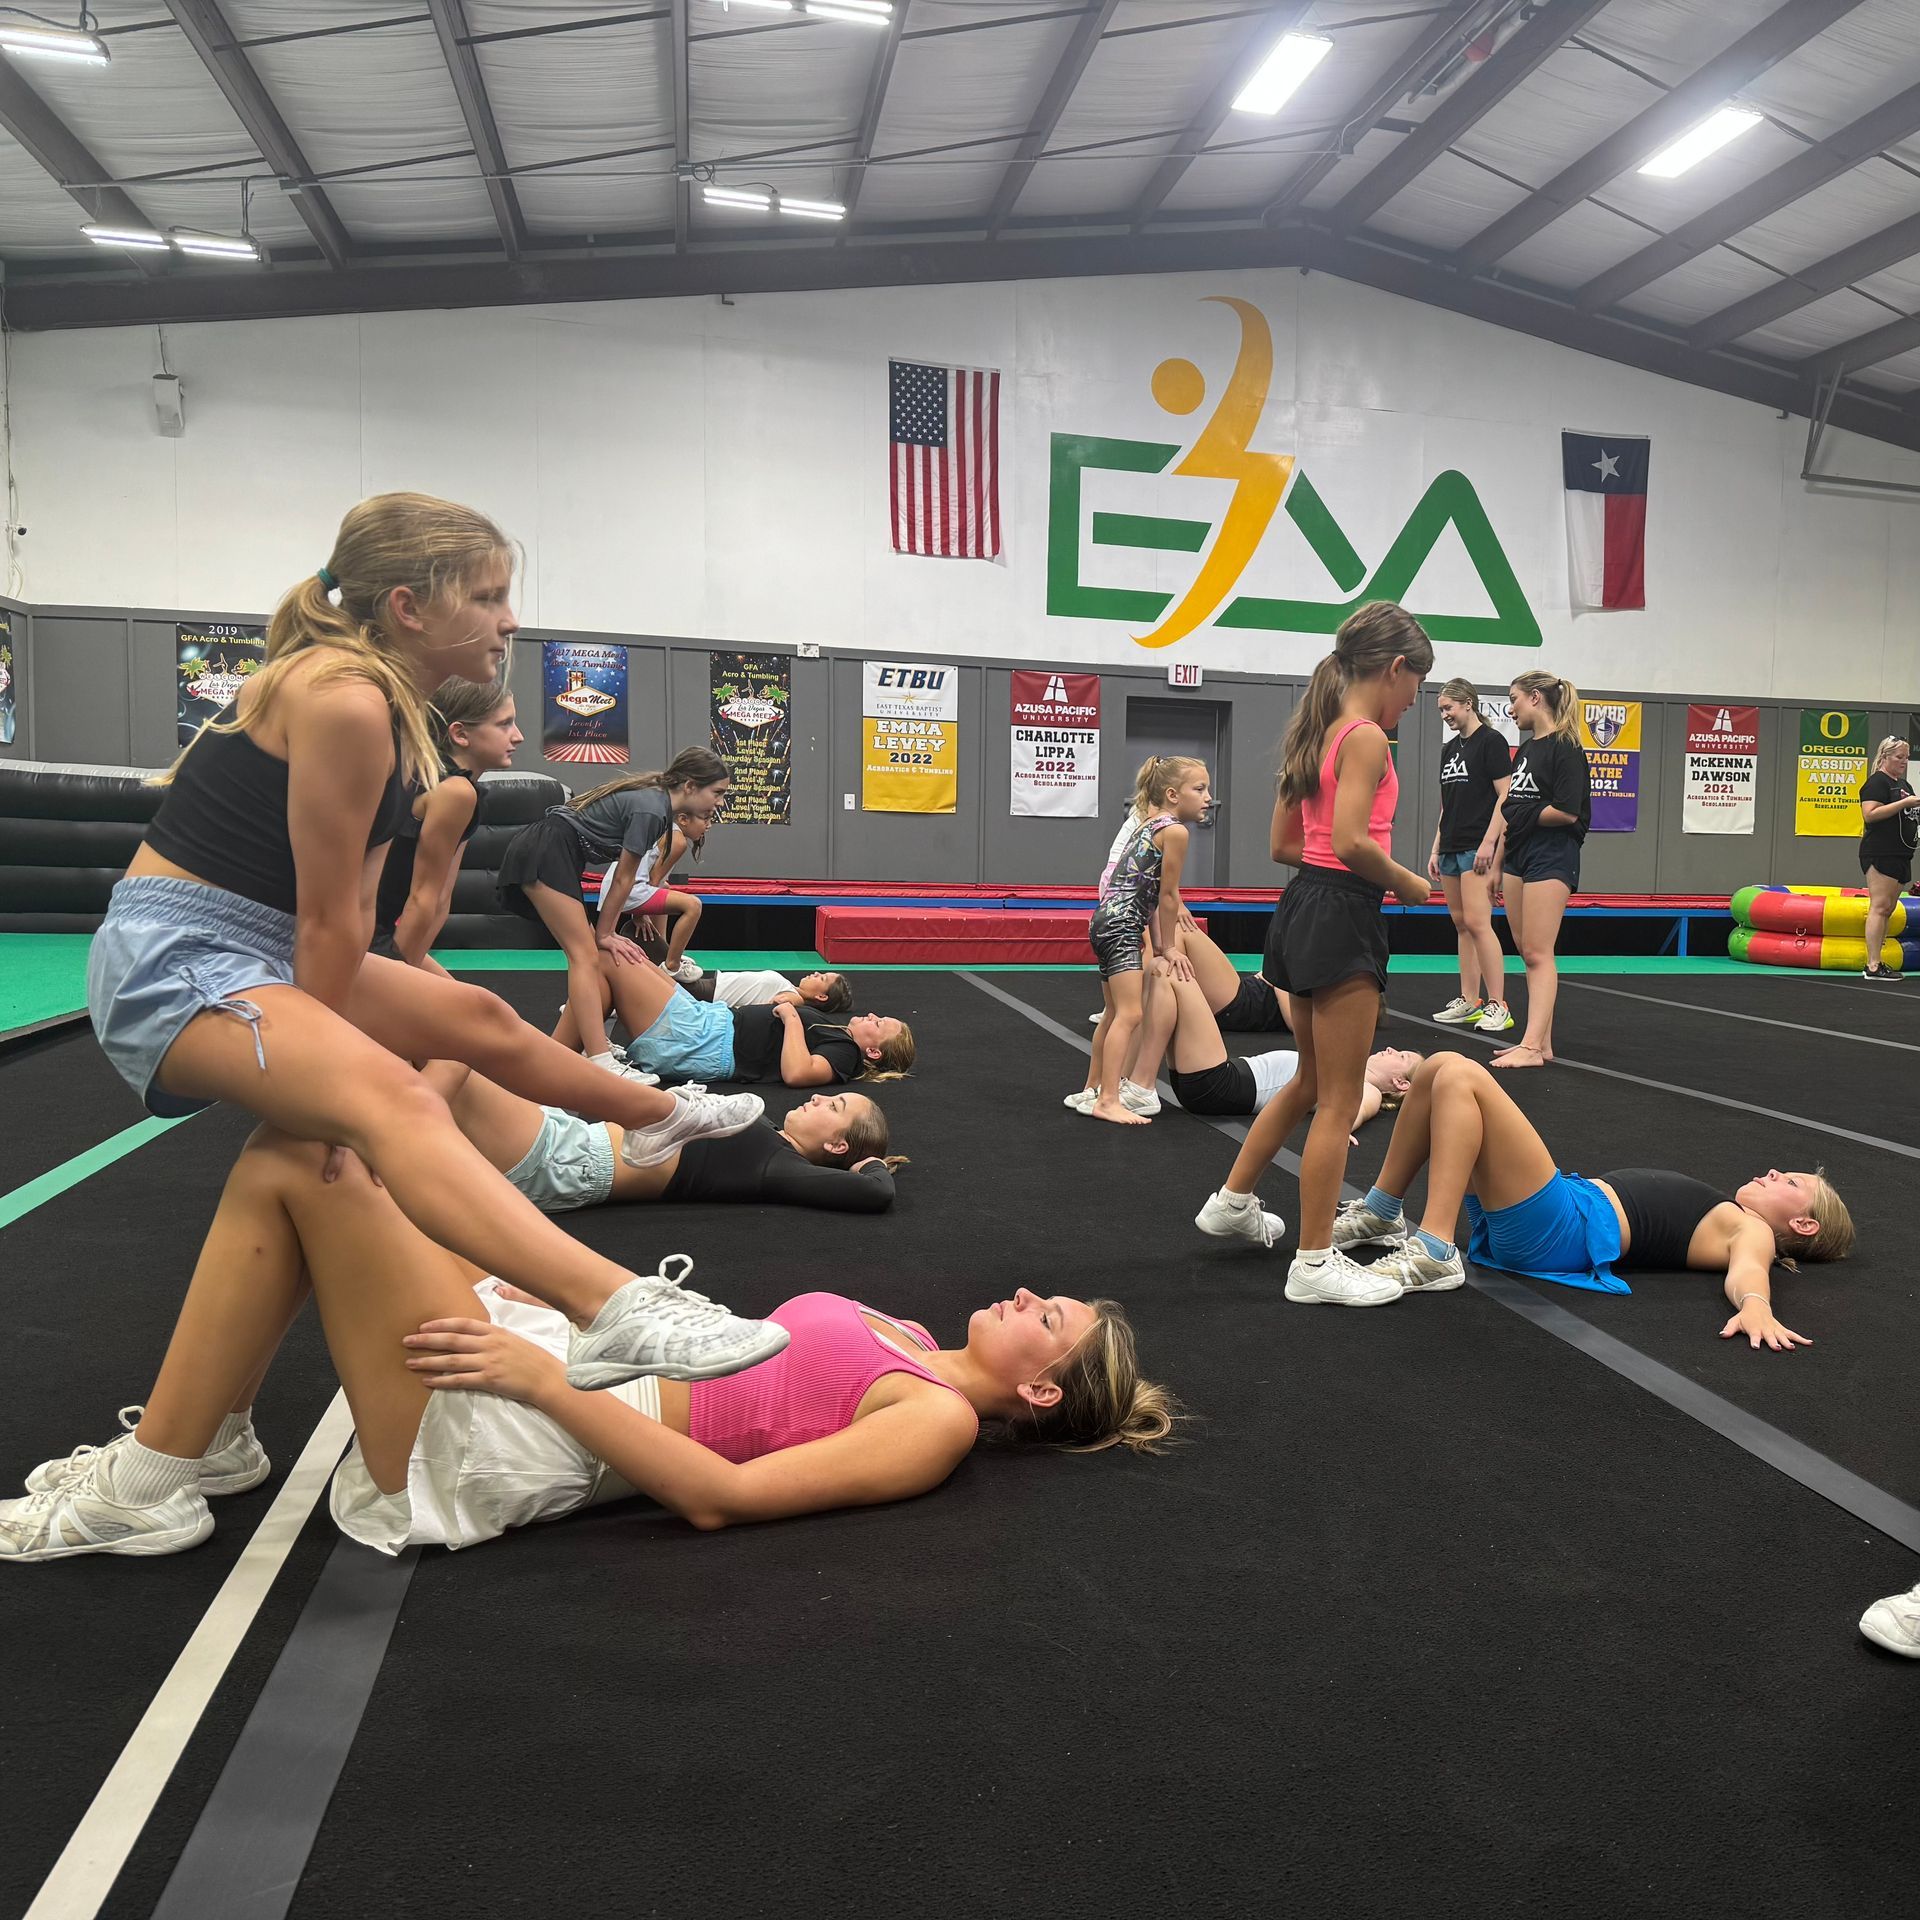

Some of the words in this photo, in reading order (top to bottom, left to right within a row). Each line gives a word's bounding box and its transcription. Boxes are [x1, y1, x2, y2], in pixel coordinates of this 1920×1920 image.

[208, 625, 238, 635] 2019
[181, 634, 198, 642] GFA
[229, 637, 265, 646] Tumbling
[572, 649, 601, 657] MEGA
[722, 670, 739, 678] Acro
[748, 672, 779, 681] Tumbling
[878, 668, 946, 690] ETBU
[1175, 664, 1199, 684] EXIT
[560, 694, 588, 704] Mega
[589, 695, 612, 704] Meet
[1015, 704, 1053, 713] AZUSA
[1055, 705, 1097, 716] PACIFIC
[1585, 704, 1626, 725] UMHB
[1023, 714, 1089, 723] UNIVERSITY
[876, 720, 943, 736] EMMA
[1820, 711, 1850, 739] O
[1016, 730, 1094, 744] CHARLOTTE
[1689, 734, 1720, 742] AZUSA
[1722, 735, 1755, 743] PACIFIC
[873, 736, 946, 752] LEVEY
[1802, 744, 1865, 754] OREGON
[1035, 746, 1075, 759] LIPPA
[721, 755, 752, 763] Saturday
[890, 752, 933, 765] 2022
[1586, 752, 1629, 765] EAGAN
[1035, 761, 1075, 772] 2022
[1800, 759, 1864, 771] CASSIDY
[1589, 767, 1623, 778] ATHE
[1692, 771, 1751, 782] DAWSON
[1808, 773, 1856, 784] AVINA
[1590, 779, 1618, 790] 2021
[1704, 784, 1734, 794] 2021
[1818, 786, 1847, 795] 2021
[721, 811, 752, 819] Saturday
